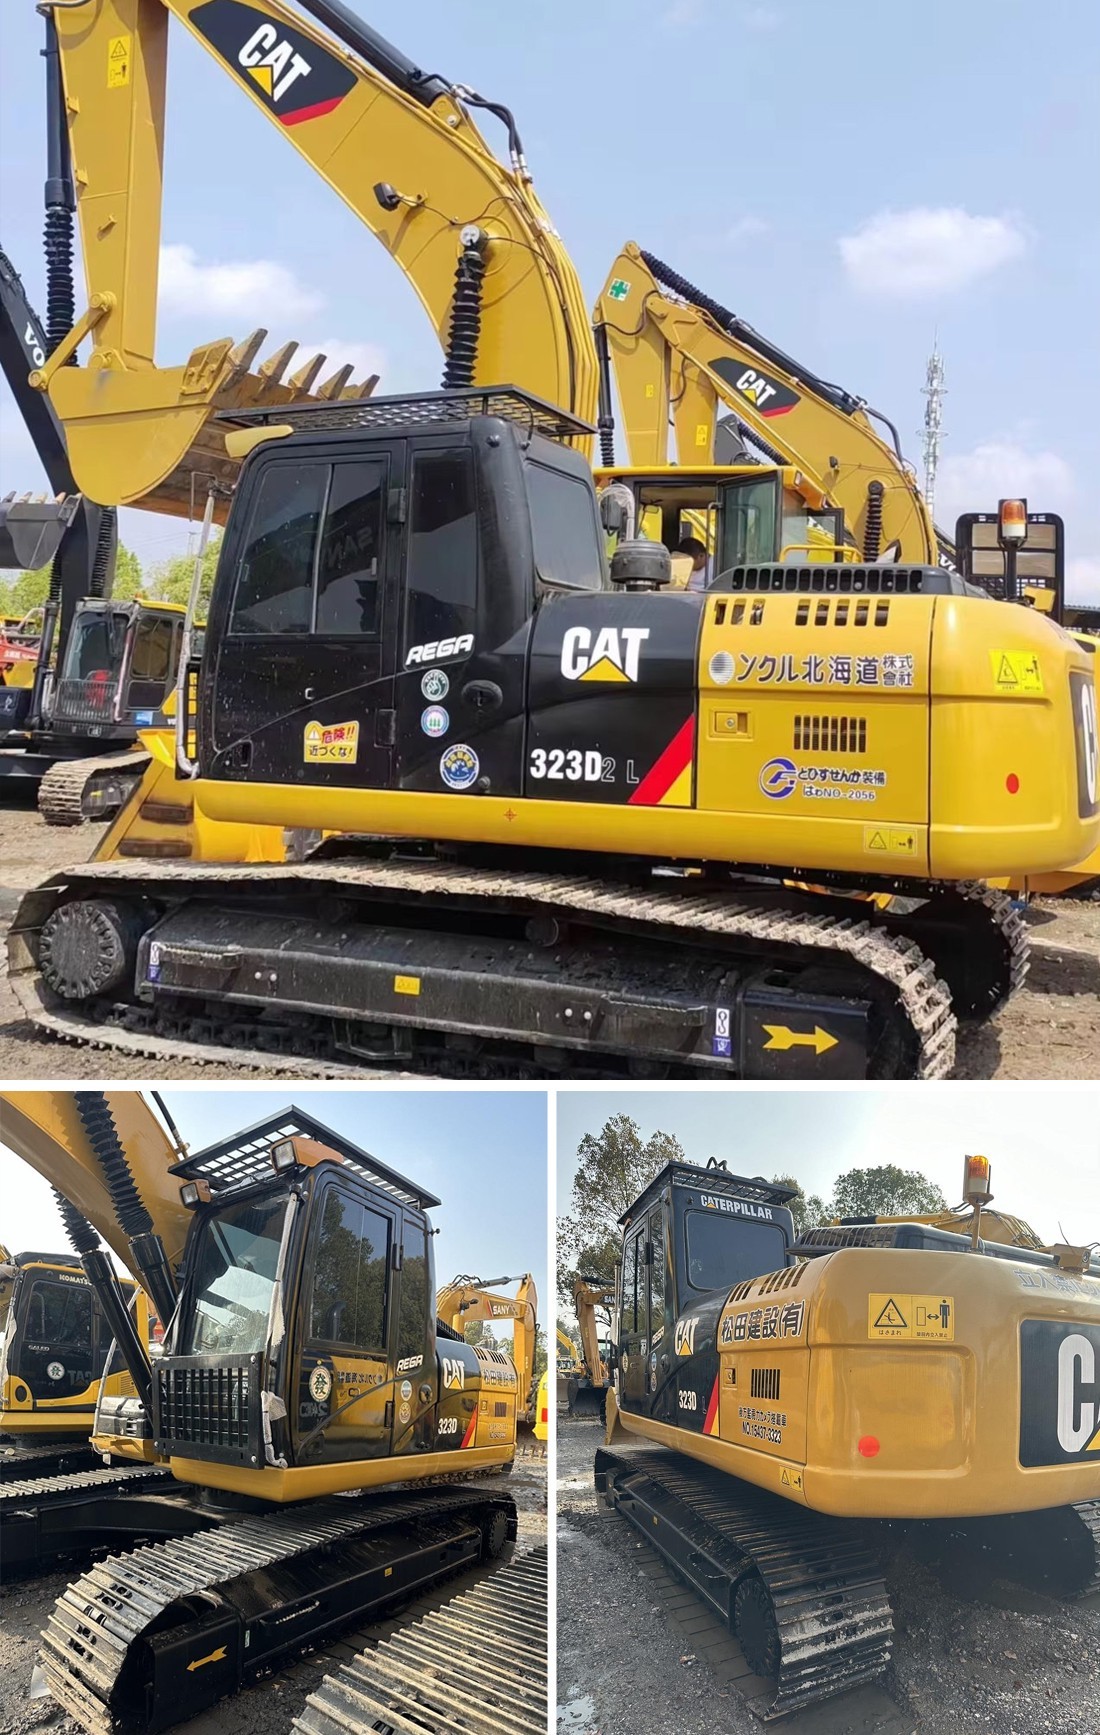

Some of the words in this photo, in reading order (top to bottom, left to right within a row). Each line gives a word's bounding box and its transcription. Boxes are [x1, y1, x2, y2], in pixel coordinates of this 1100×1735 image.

[238, 24, 312, 102] CAT
[736, 369, 777, 406] CAT
[405, 634, 475, 666] REGA
[560, 626, 650, 683] CAT
[626, 759, 640, 784] L
[700, 1194, 773, 1220] CATERPILLAR
[492, 1304, 511, 1316] SANY
[674, 1317, 700, 1356] CAT
[397, 1354, 424, 1373] REGA
[443, 1357, 465, 1390] CAT
[678, 1390, 697, 1411] 323D
[438, 1417, 458, 1435] 323D
